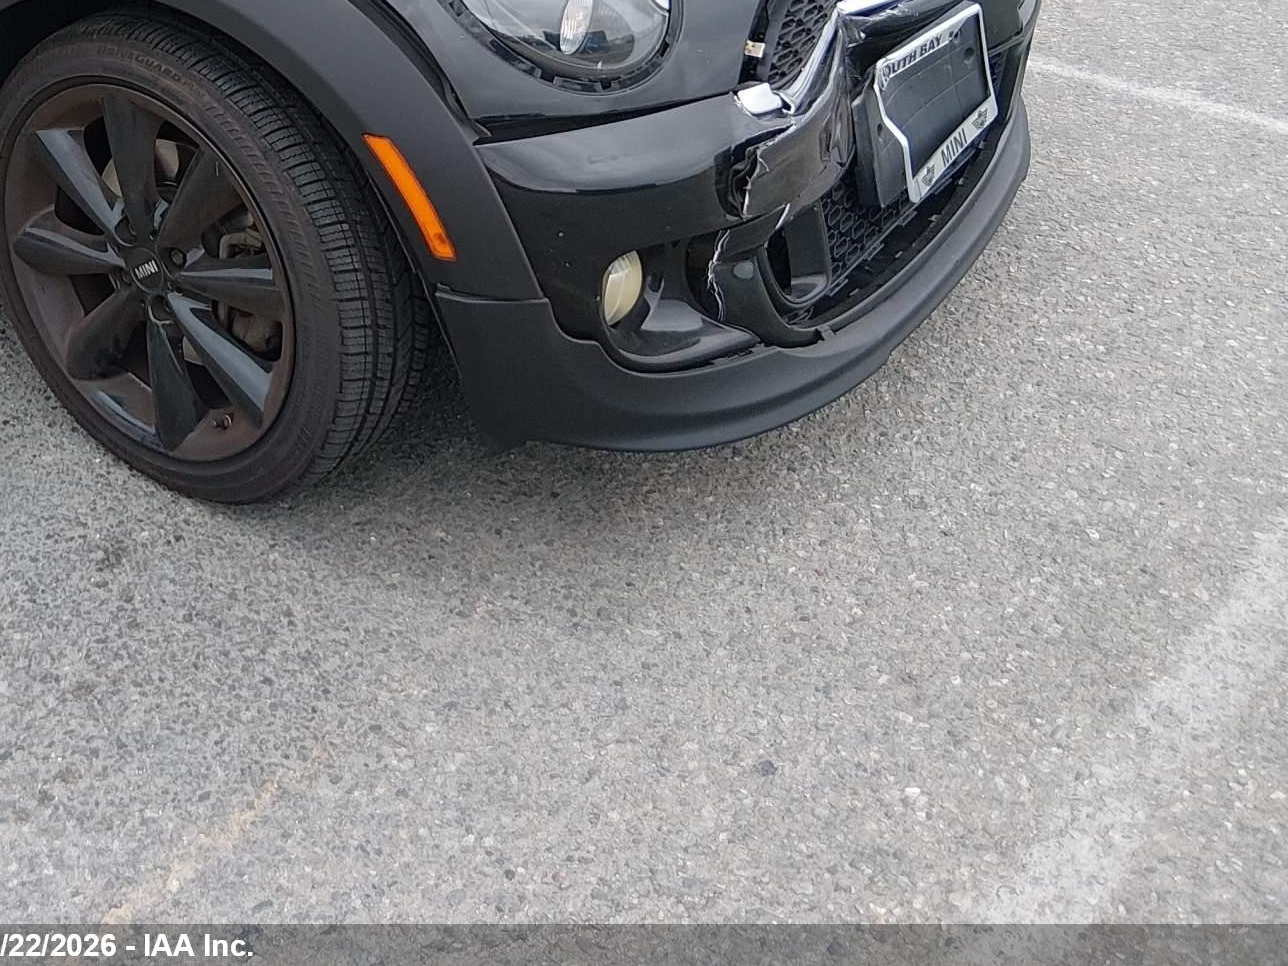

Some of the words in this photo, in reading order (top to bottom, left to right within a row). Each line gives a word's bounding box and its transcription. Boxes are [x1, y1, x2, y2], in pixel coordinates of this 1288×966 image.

[920, 34, 943, 53] BAY
[940, 128, 968, 167] MINI
[134, 259, 158, 279] MINI
